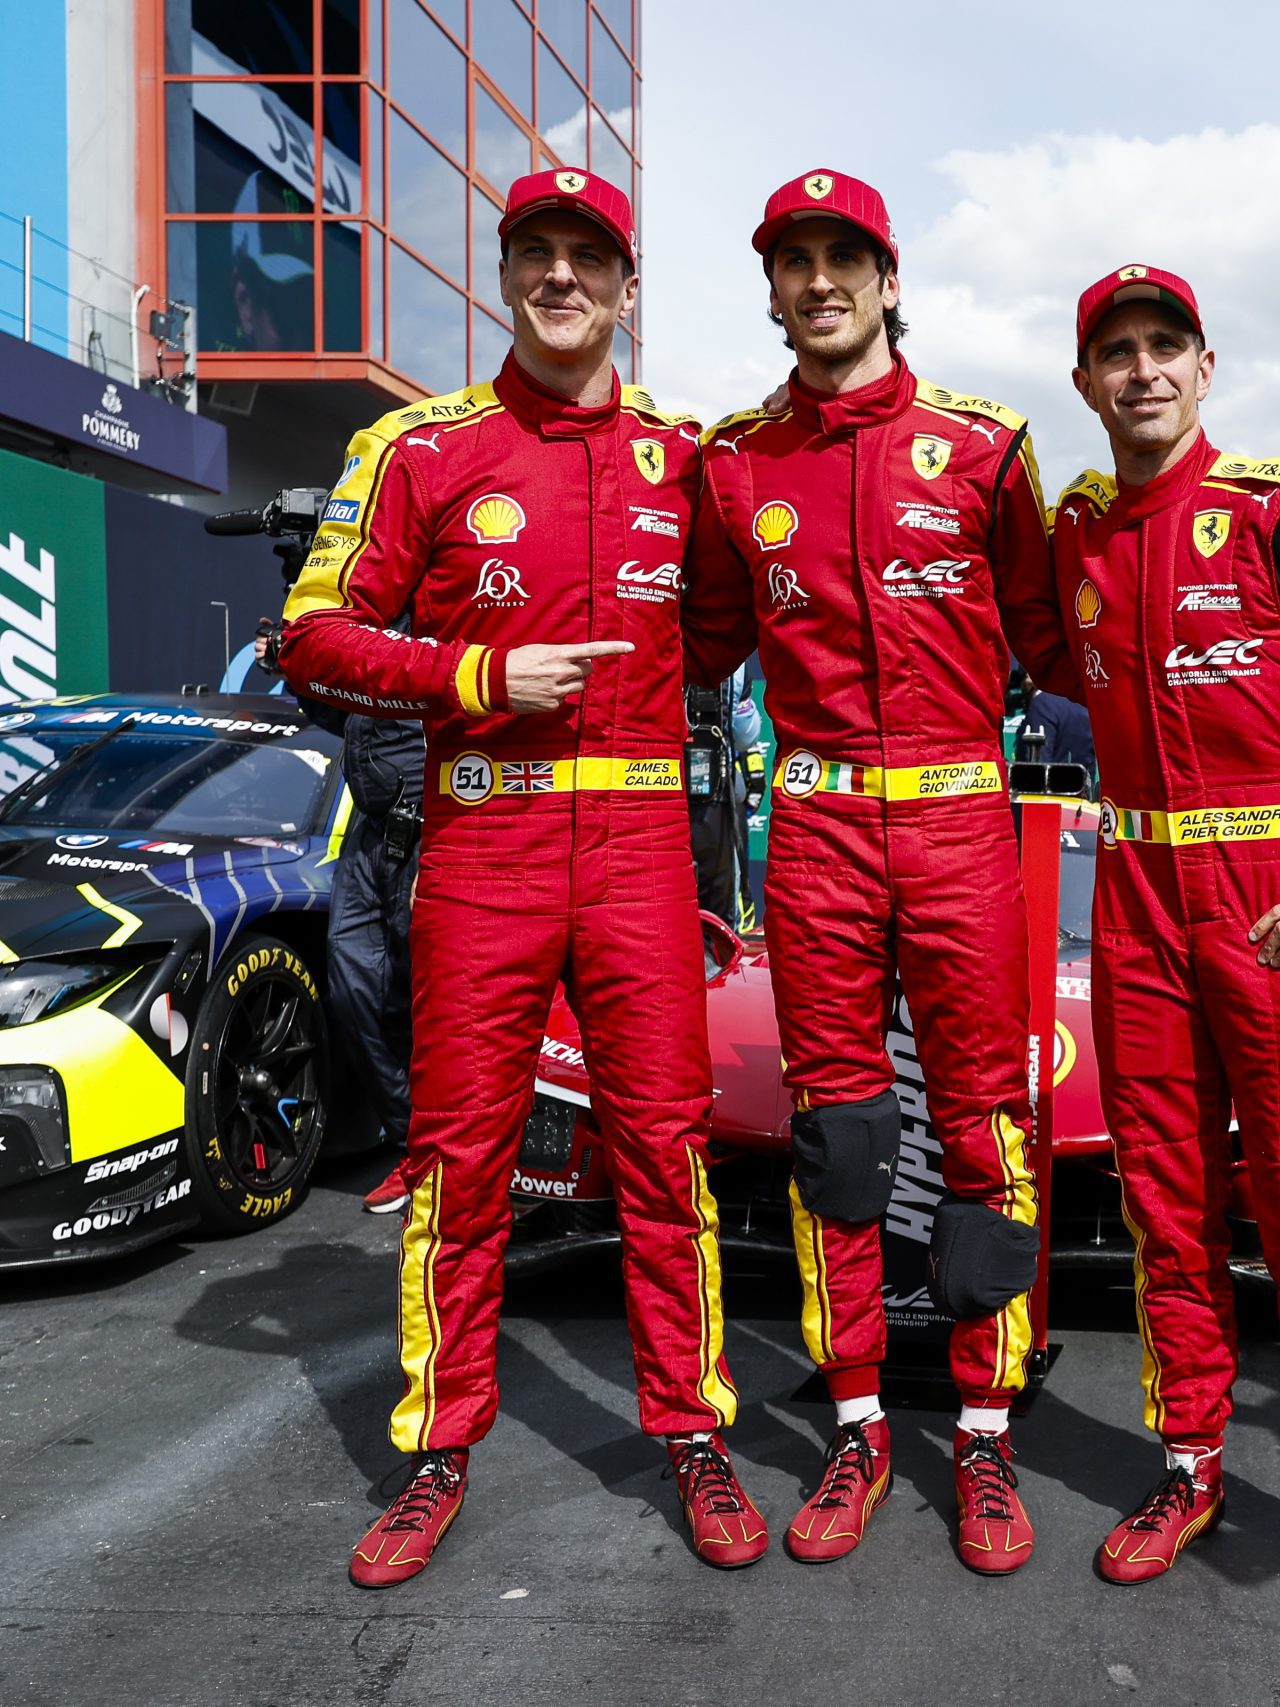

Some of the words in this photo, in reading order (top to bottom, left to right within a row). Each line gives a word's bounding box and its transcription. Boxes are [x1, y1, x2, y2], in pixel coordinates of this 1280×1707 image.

[431, 395, 476, 417] AT&T
[955, 399, 1005, 413] AT&T
[82, 413, 140, 450] POMMERY
[628, 505, 653, 514] RACING
[654, 510, 679, 519] PARTNER
[896, 501, 925, 509] RACING
[926, 505, 959, 515] PARTNER
[882, 559, 971, 583] WEC
[616, 583, 626, 591] FIA
[628, 585, 653, 595] WORLD
[898, 583, 926, 591] WORLD
[616, 591, 665, 603] CHAMPIONSHIP
[1165, 639, 1264, 668] WEC
[1167, 677, 1228, 686] CHAMPIONSHIP
[1182, 670, 1210, 678] WORLD
[1212, 669, 1261, 677] ENDURANCE
[309, 681, 374, 707] RICHARD
[377, 699, 429, 710] MILLE
[122, 712, 299, 737] Motorsport
[625, 762, 670, 773] JAMES
[786, 762, 815, 785] 51
[919, 765, 983, 781] ANTONIO
[456, 766, 487, 790] 51
[624, 775, 679, 786] CALADO
[919, 777, 998, 794] GIOVINAZZI
[1181, 826, 1217, 840] PIER
[1222, 823, 1270, 837] GUIDI
[83, 1138, 179, 1184] Snap-on
[239, 1187, 292, 1217] EAGLE
